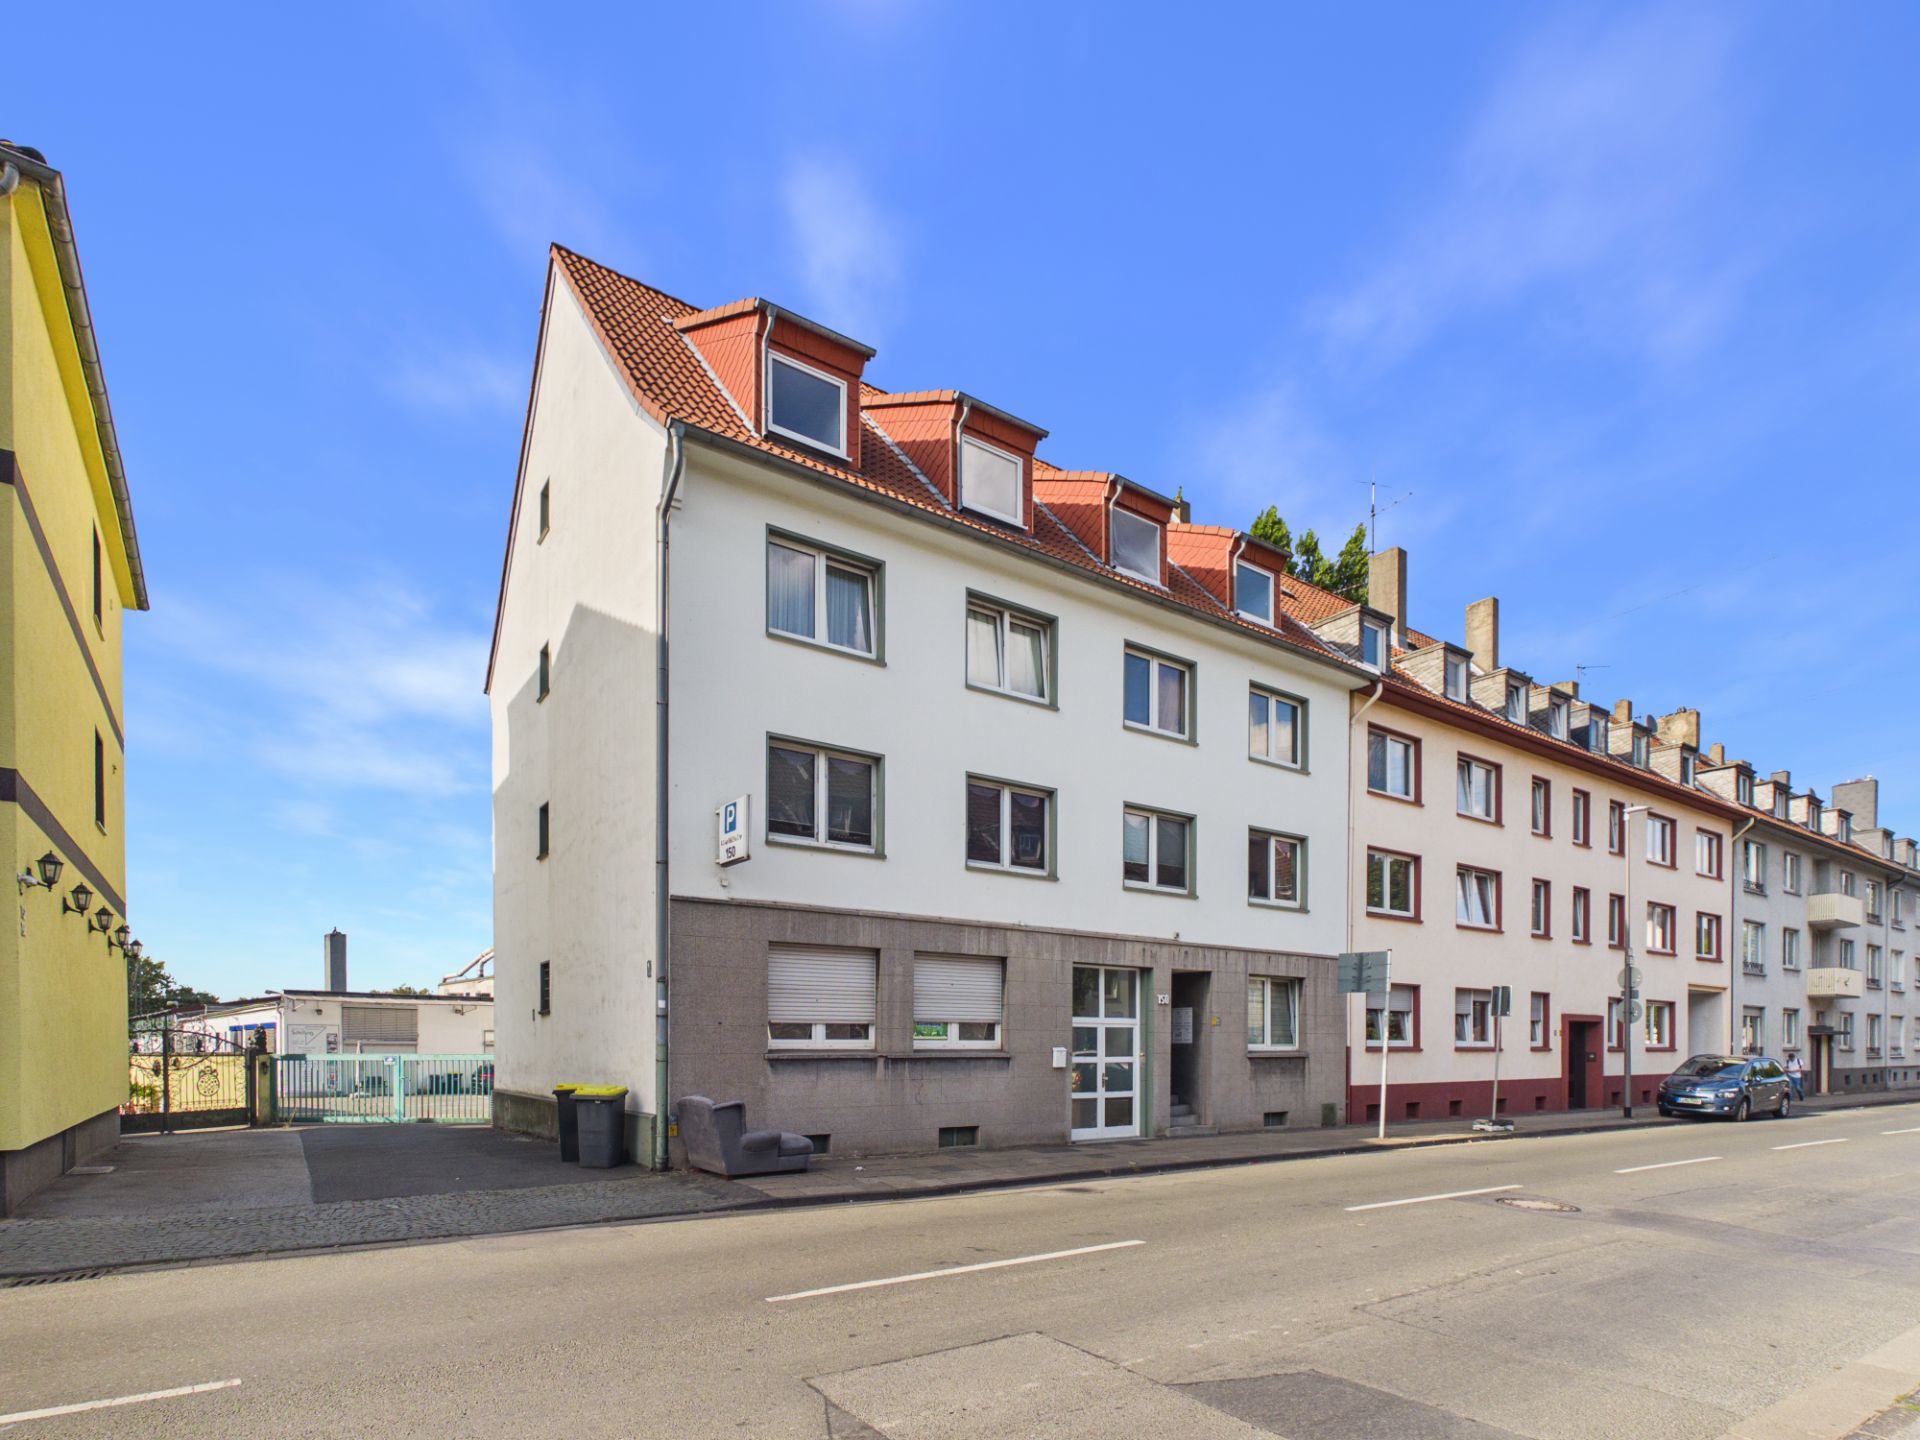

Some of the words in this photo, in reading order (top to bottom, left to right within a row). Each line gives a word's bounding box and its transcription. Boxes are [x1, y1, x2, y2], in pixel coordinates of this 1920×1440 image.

[726, 805, 735, 832] P
[726, 846, 736, 859] 150
[1157, 993, 1169, 1004] 150
